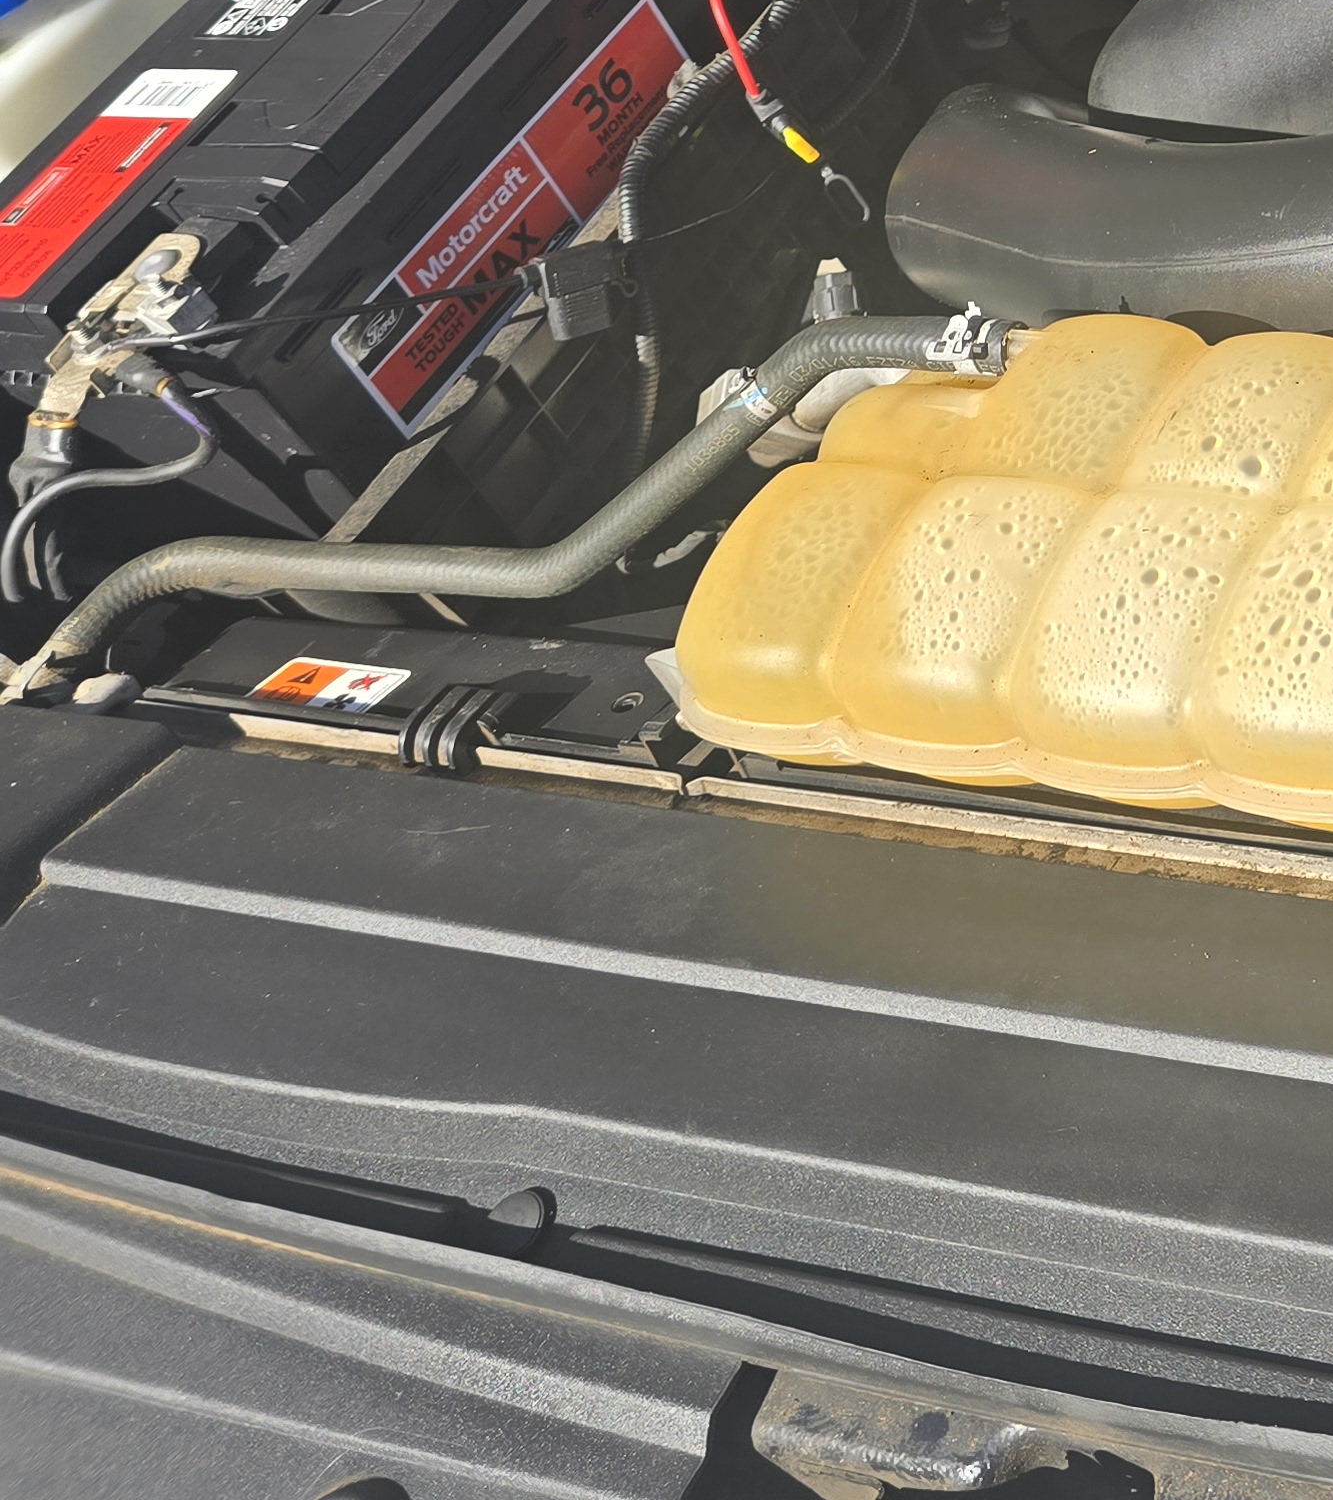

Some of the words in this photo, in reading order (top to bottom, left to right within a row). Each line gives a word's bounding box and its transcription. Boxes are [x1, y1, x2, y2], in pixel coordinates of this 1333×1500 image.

[571, 56, 634, 133] 36
[596, 91, 645, 147] MONTH
[414, 163, 529, 290] Motorcraft
[461, 217, 541, 317] MAX
[365, 309, 399, 347] Ford
[404, 301, 459, 362] TESTED
